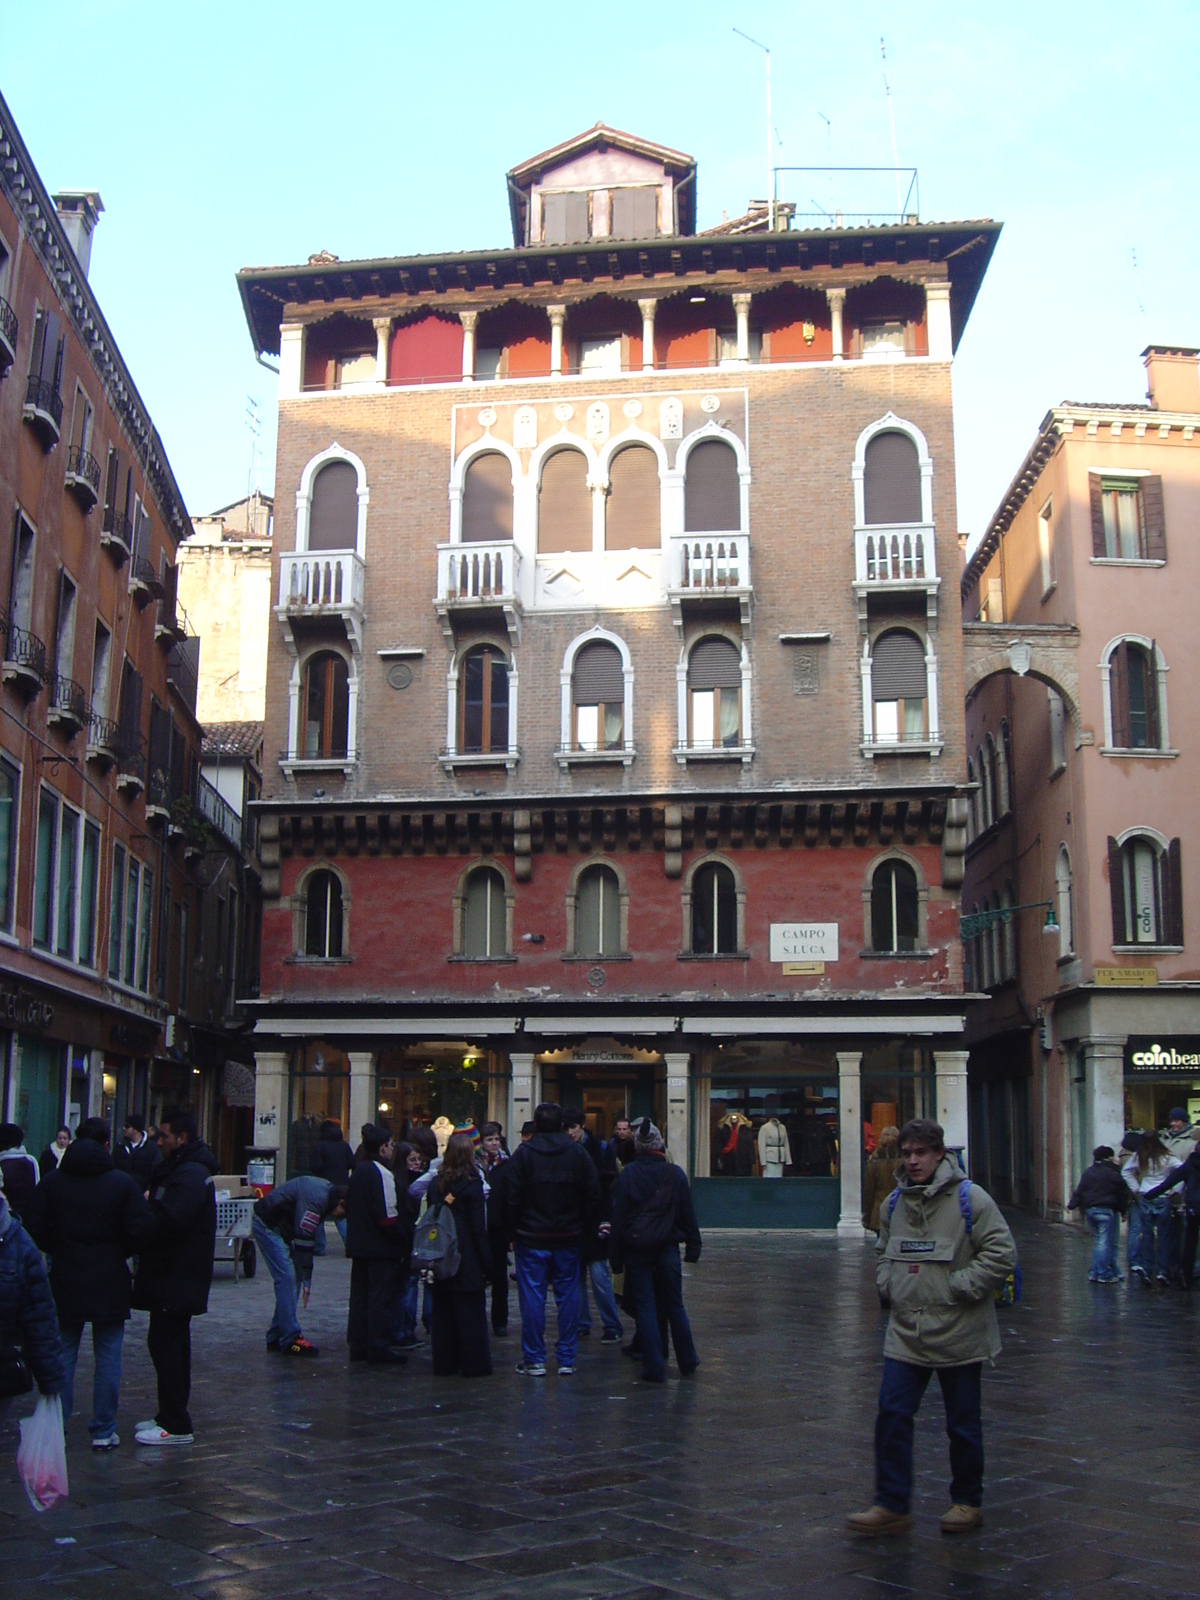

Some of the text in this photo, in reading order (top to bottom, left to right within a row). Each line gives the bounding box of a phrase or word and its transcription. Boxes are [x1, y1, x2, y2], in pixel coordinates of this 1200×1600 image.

[782, 930, 825, 939] CAMPO
[1097, 969, 1114, 977] PER
[572, 1050, 598, 1062] Henry
[1132, 1043, 1200, 1066] coinbea
